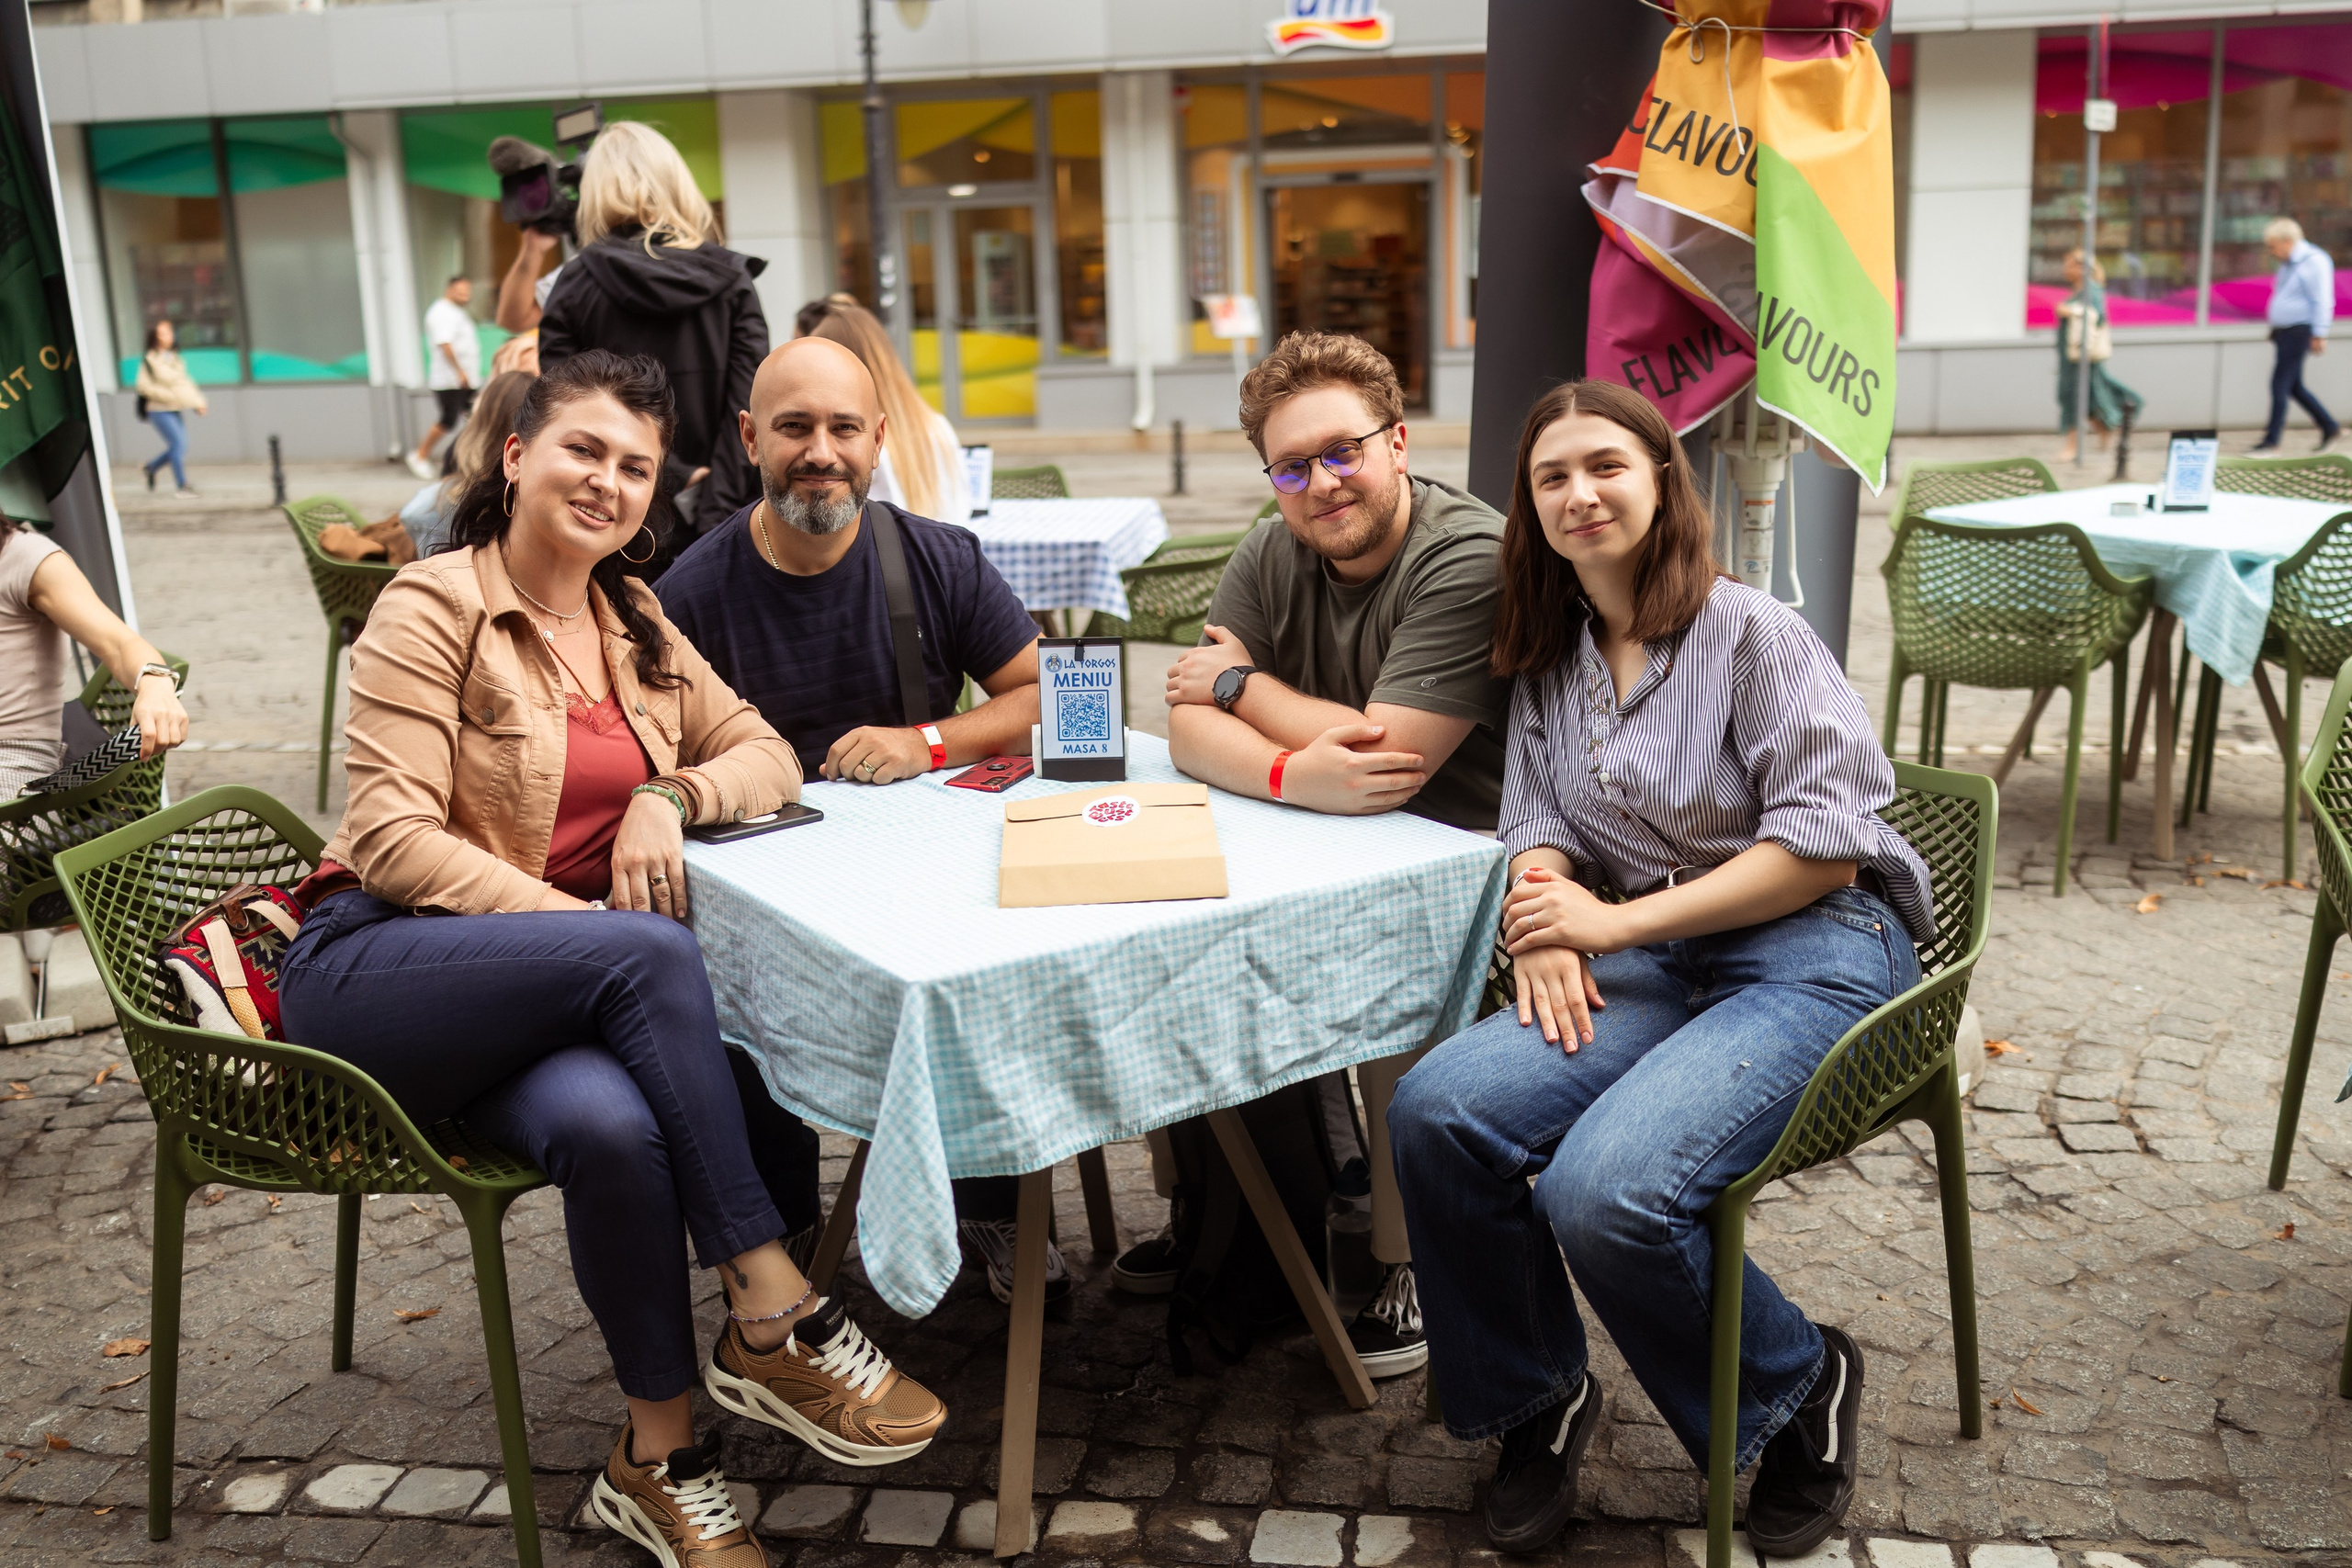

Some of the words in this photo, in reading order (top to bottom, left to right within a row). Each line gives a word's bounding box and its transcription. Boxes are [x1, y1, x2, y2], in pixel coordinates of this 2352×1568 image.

[1757, 290, 1880, 417] VOURS
[1064, 659, 1075, 669] LA
[1080, 658, 1116, 669] YORGOS
[1053, 671, 1112, 688] MENIU
[1062, 743, 1097, 754] MASA
[1102, 742, 1108, 753] 8
